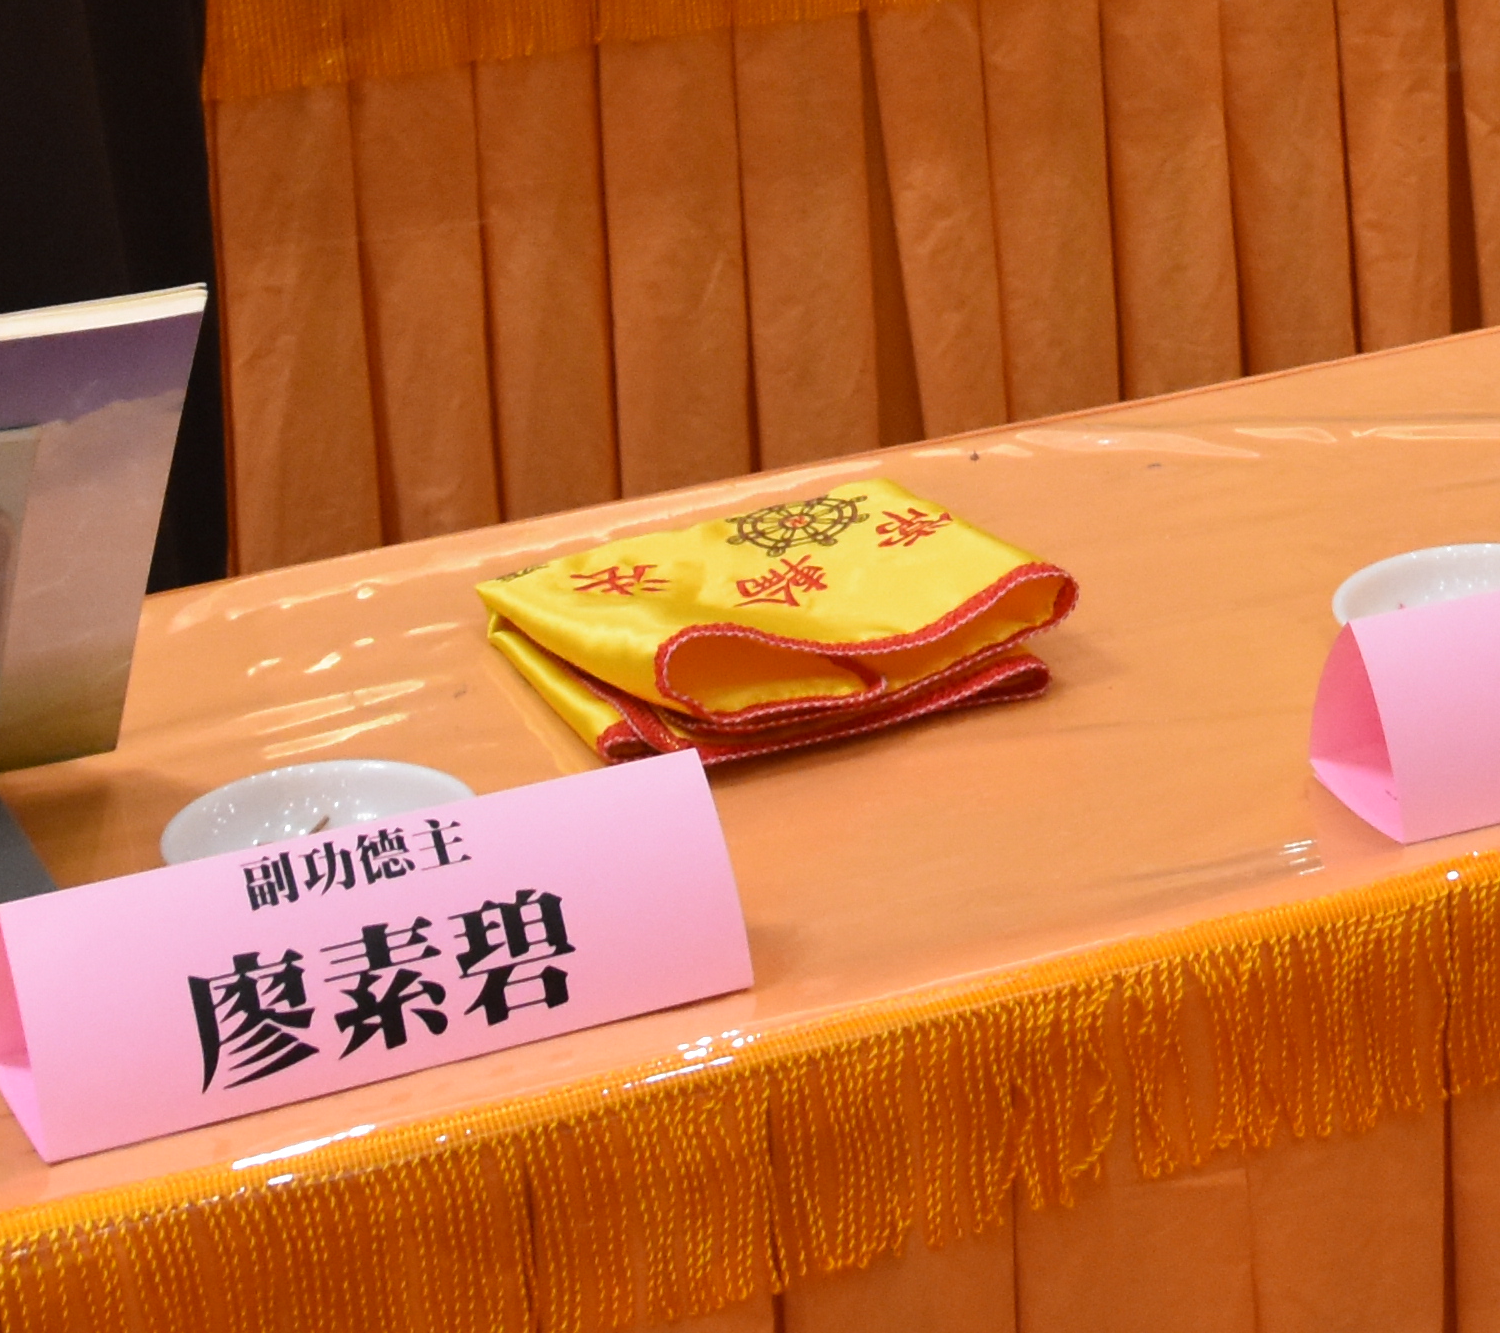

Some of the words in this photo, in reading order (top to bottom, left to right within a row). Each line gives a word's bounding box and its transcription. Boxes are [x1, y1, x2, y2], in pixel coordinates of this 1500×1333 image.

[242, 818, 473, 912] 副功德主
[187, 888, 577, 1096] 廖素碧
